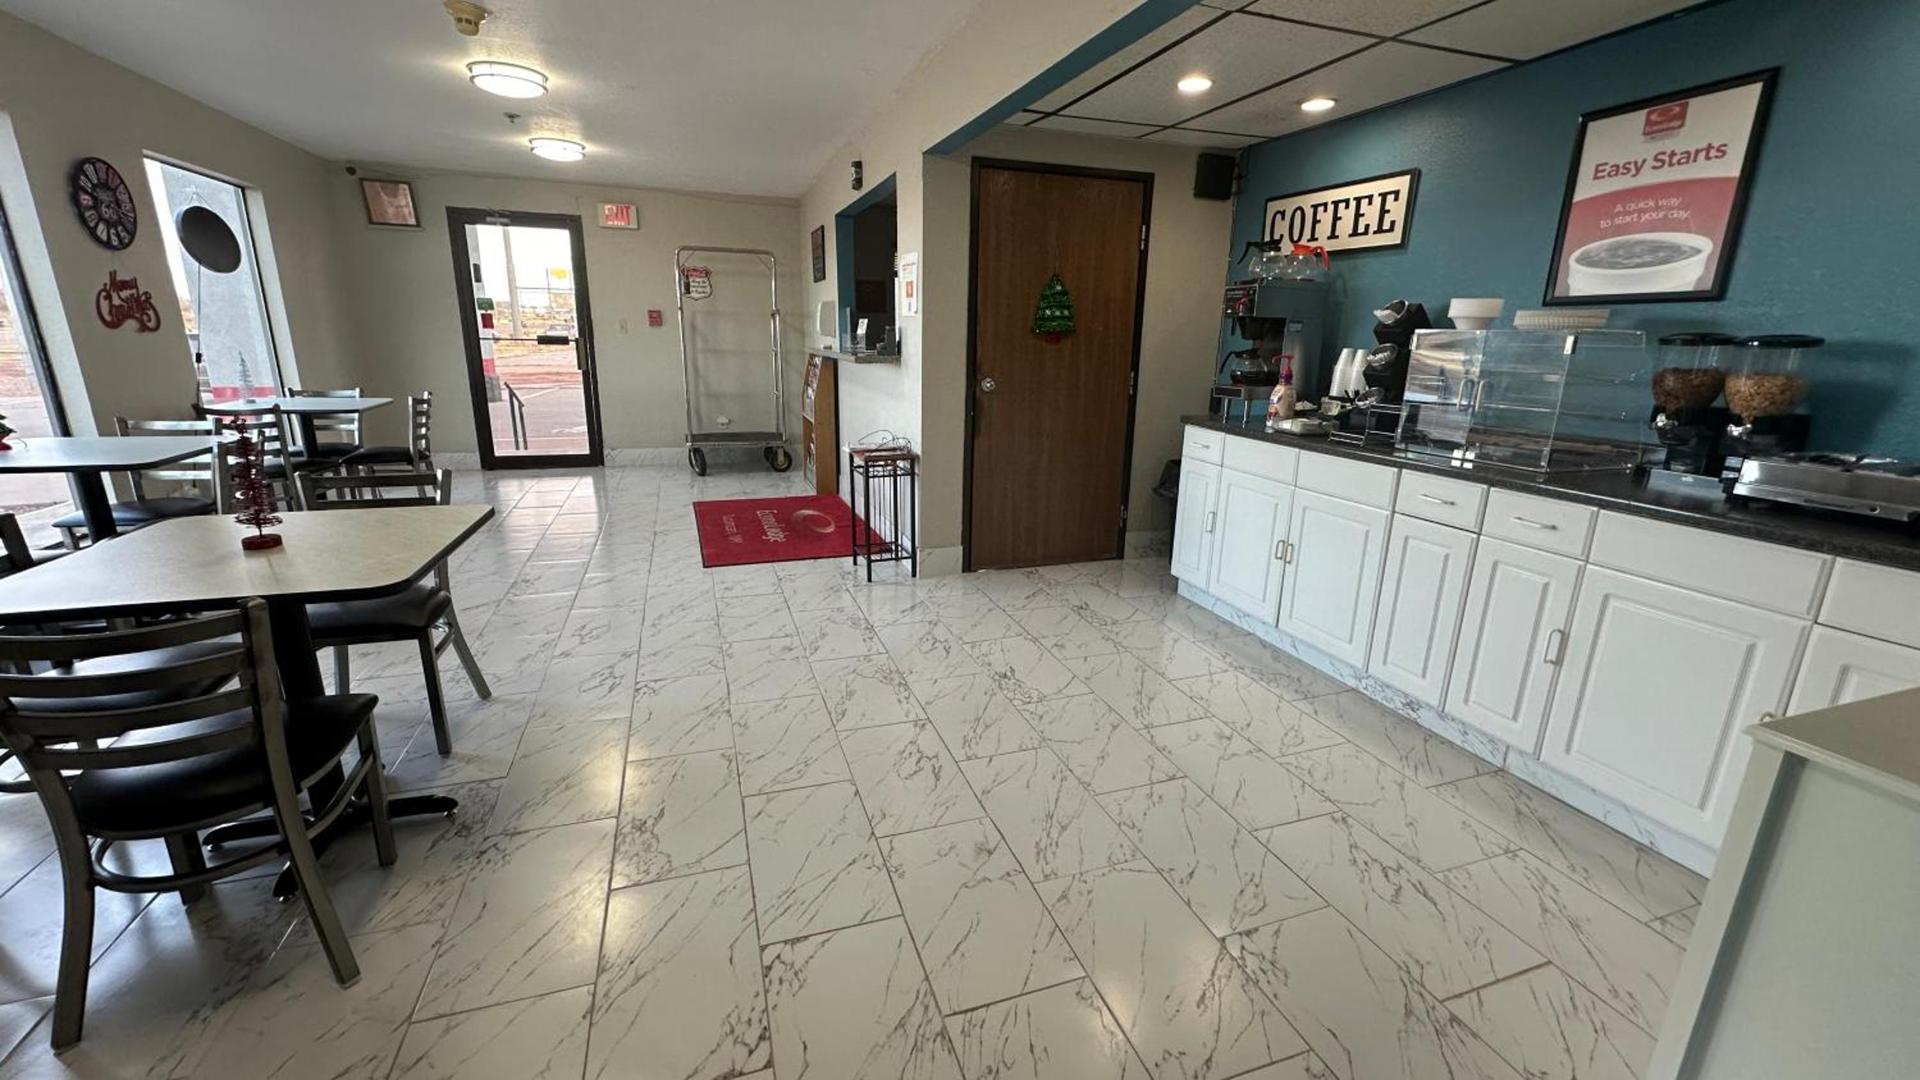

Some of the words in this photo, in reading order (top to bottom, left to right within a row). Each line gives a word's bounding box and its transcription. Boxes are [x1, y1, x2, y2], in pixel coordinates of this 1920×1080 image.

[1592, 158, 1647, 181] Easy
[1651, 142, 1728, 171] Starts
[1269, 189, 1401, 245] COFFEE
[1614, 203, 1623, 213] A
[1625, 197, 1656, 212] quick
[1659, 195, 1682, 207] way
[1599, 219, 1612, 229] to
[1613, 212, 1639, 225] start
[1640, 209, 1666, 224] your
